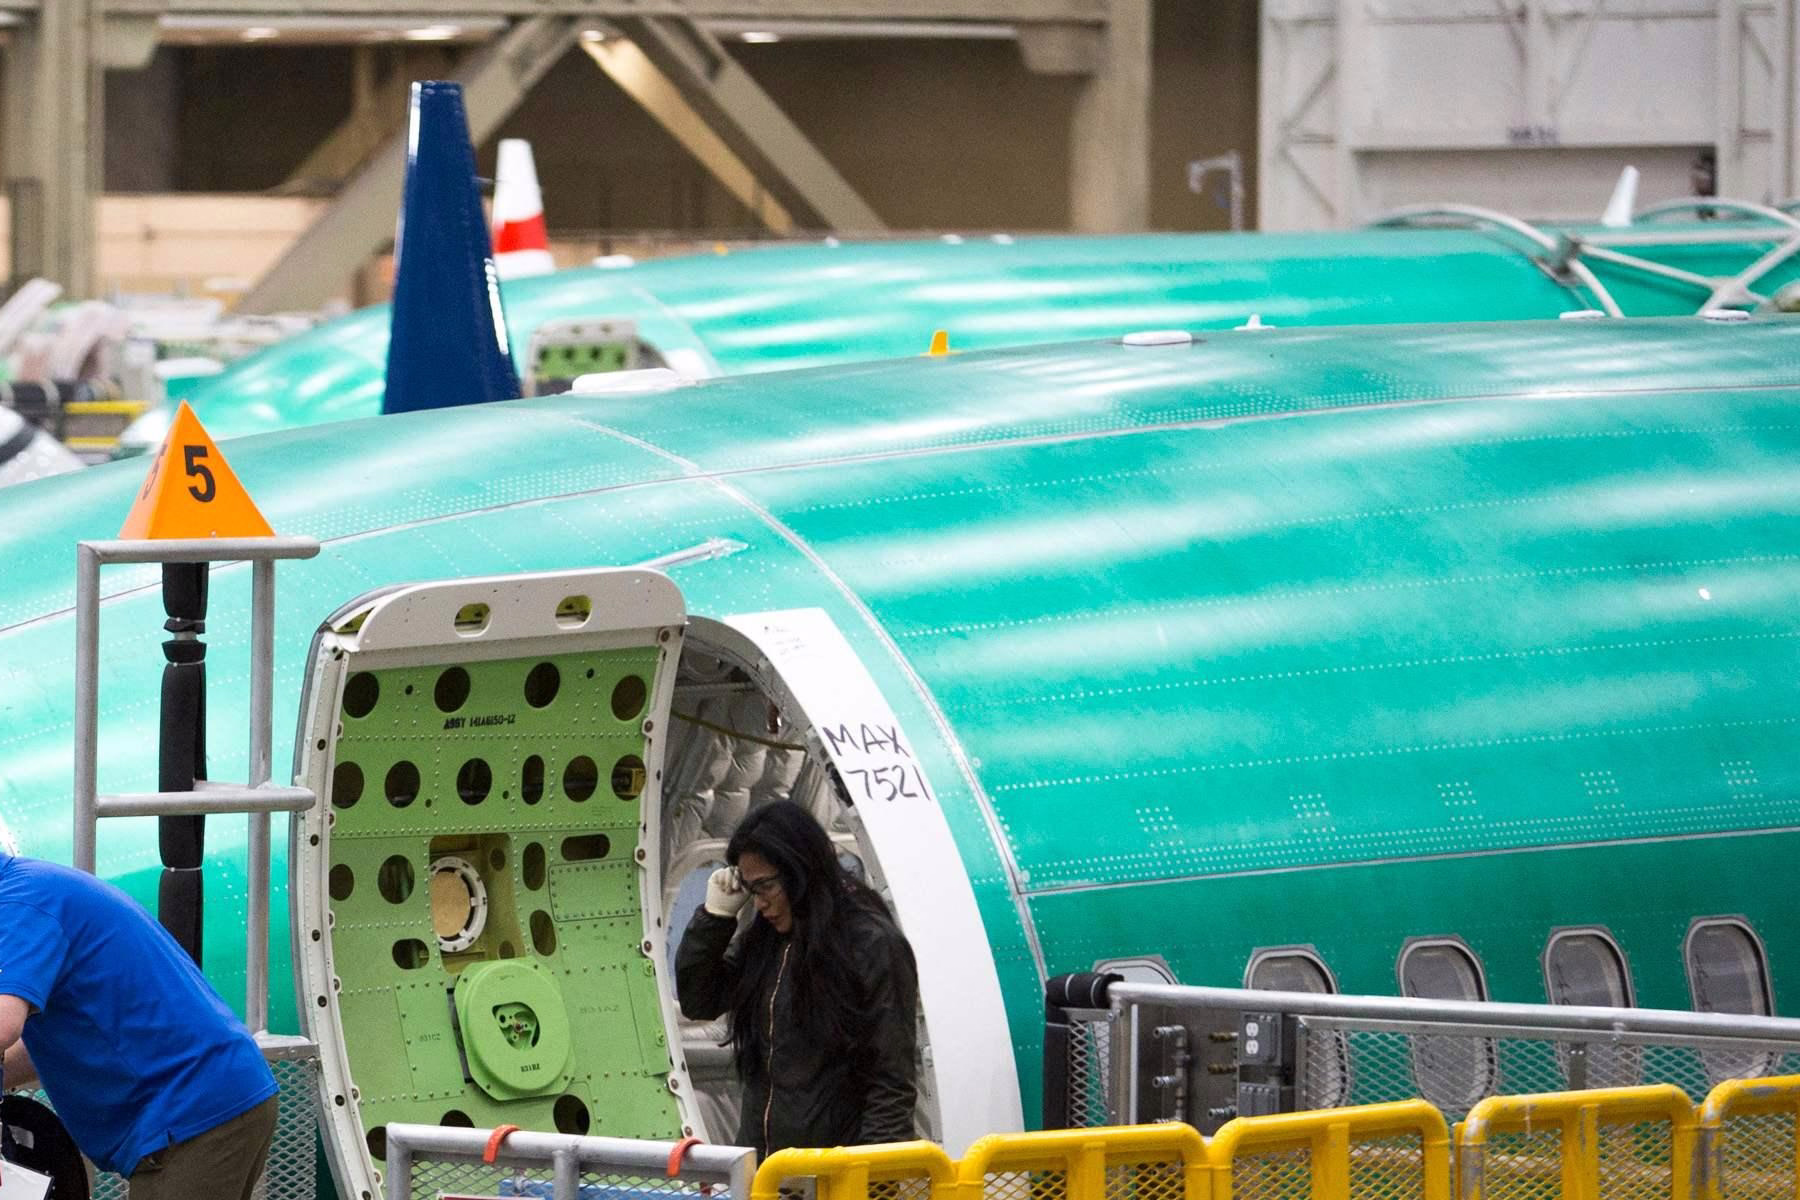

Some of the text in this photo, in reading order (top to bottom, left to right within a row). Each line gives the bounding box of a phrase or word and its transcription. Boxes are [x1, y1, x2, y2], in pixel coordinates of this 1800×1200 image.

[184, 445, 216, 502] 5
[822, 723, 910, 757] MAX
[845, 764, 931, 801] 7521
